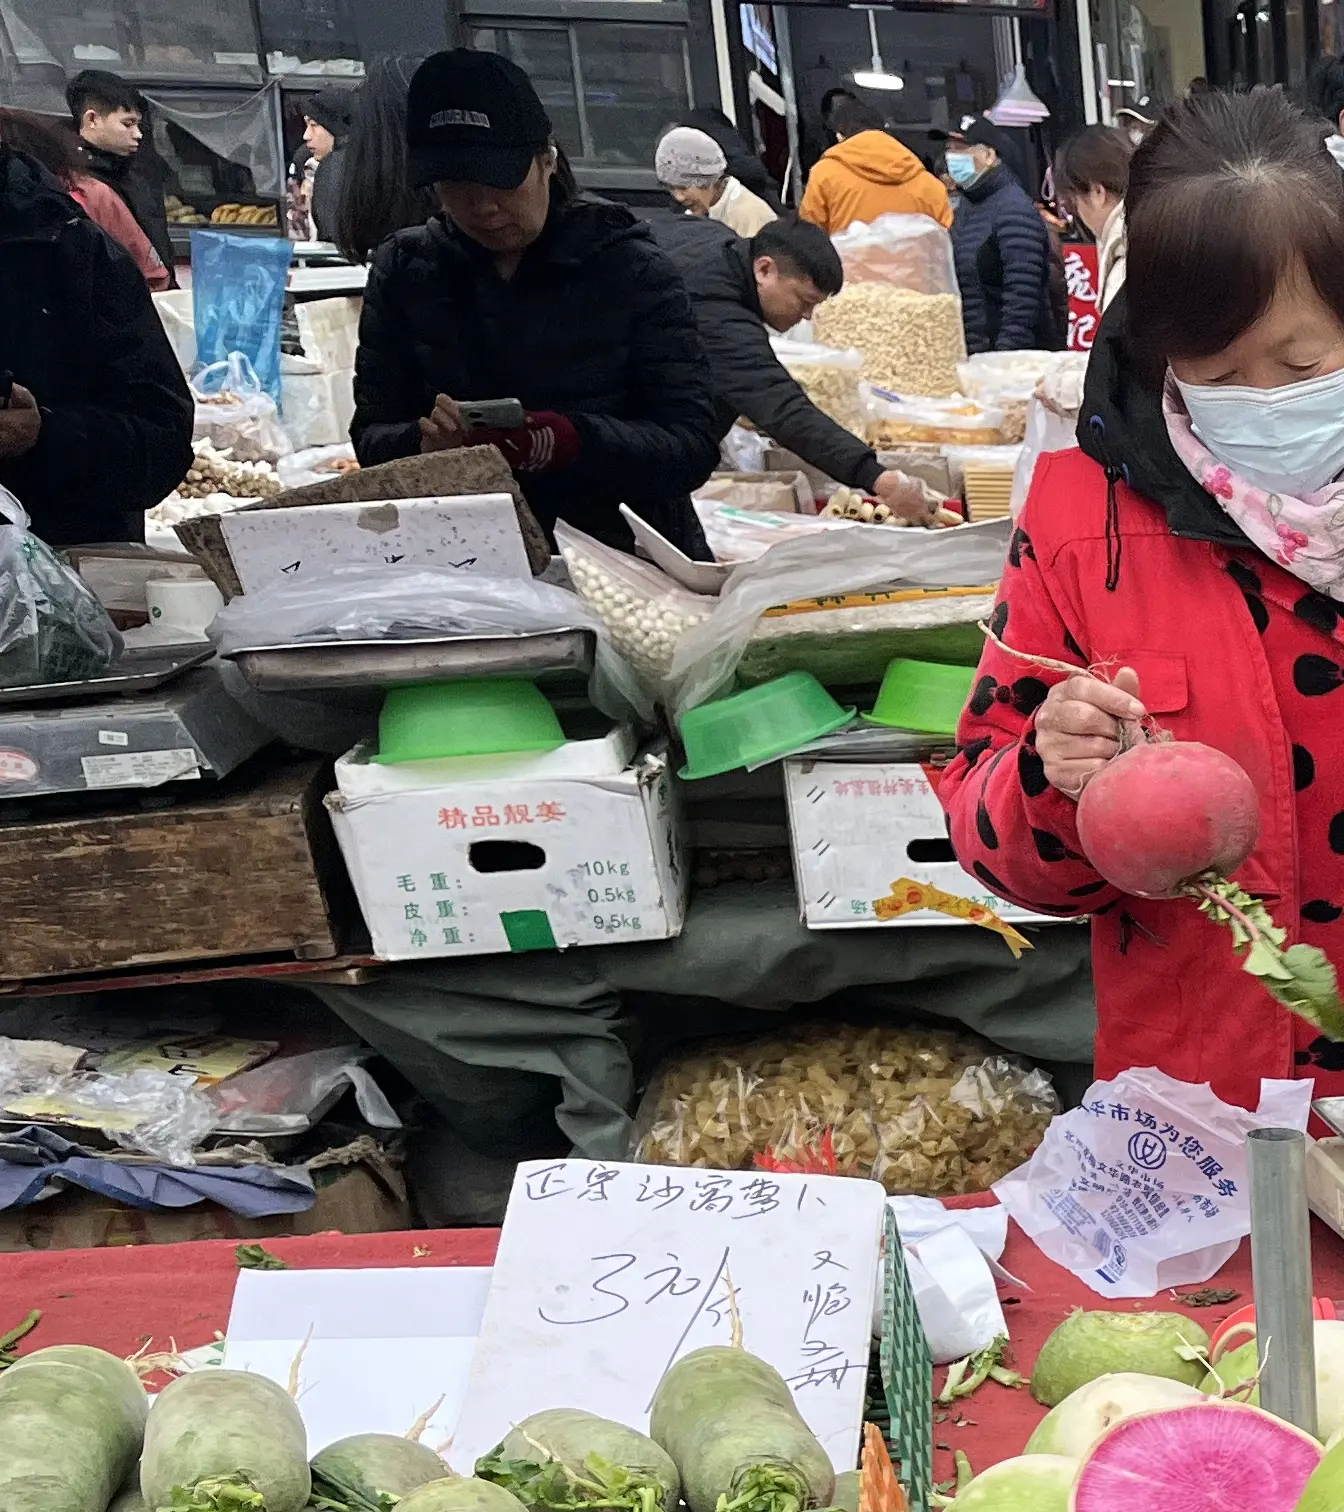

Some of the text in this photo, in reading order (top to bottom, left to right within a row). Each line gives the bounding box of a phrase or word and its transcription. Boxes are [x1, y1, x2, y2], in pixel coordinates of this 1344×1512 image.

[437, 800, 567, 829] 精品靓姜
[587, 887, 637, 905] 0.5kg
[592, 914, 642, 933] 9.5kg
[1077, 1099, 1239, 1199] 华市场为您服务
